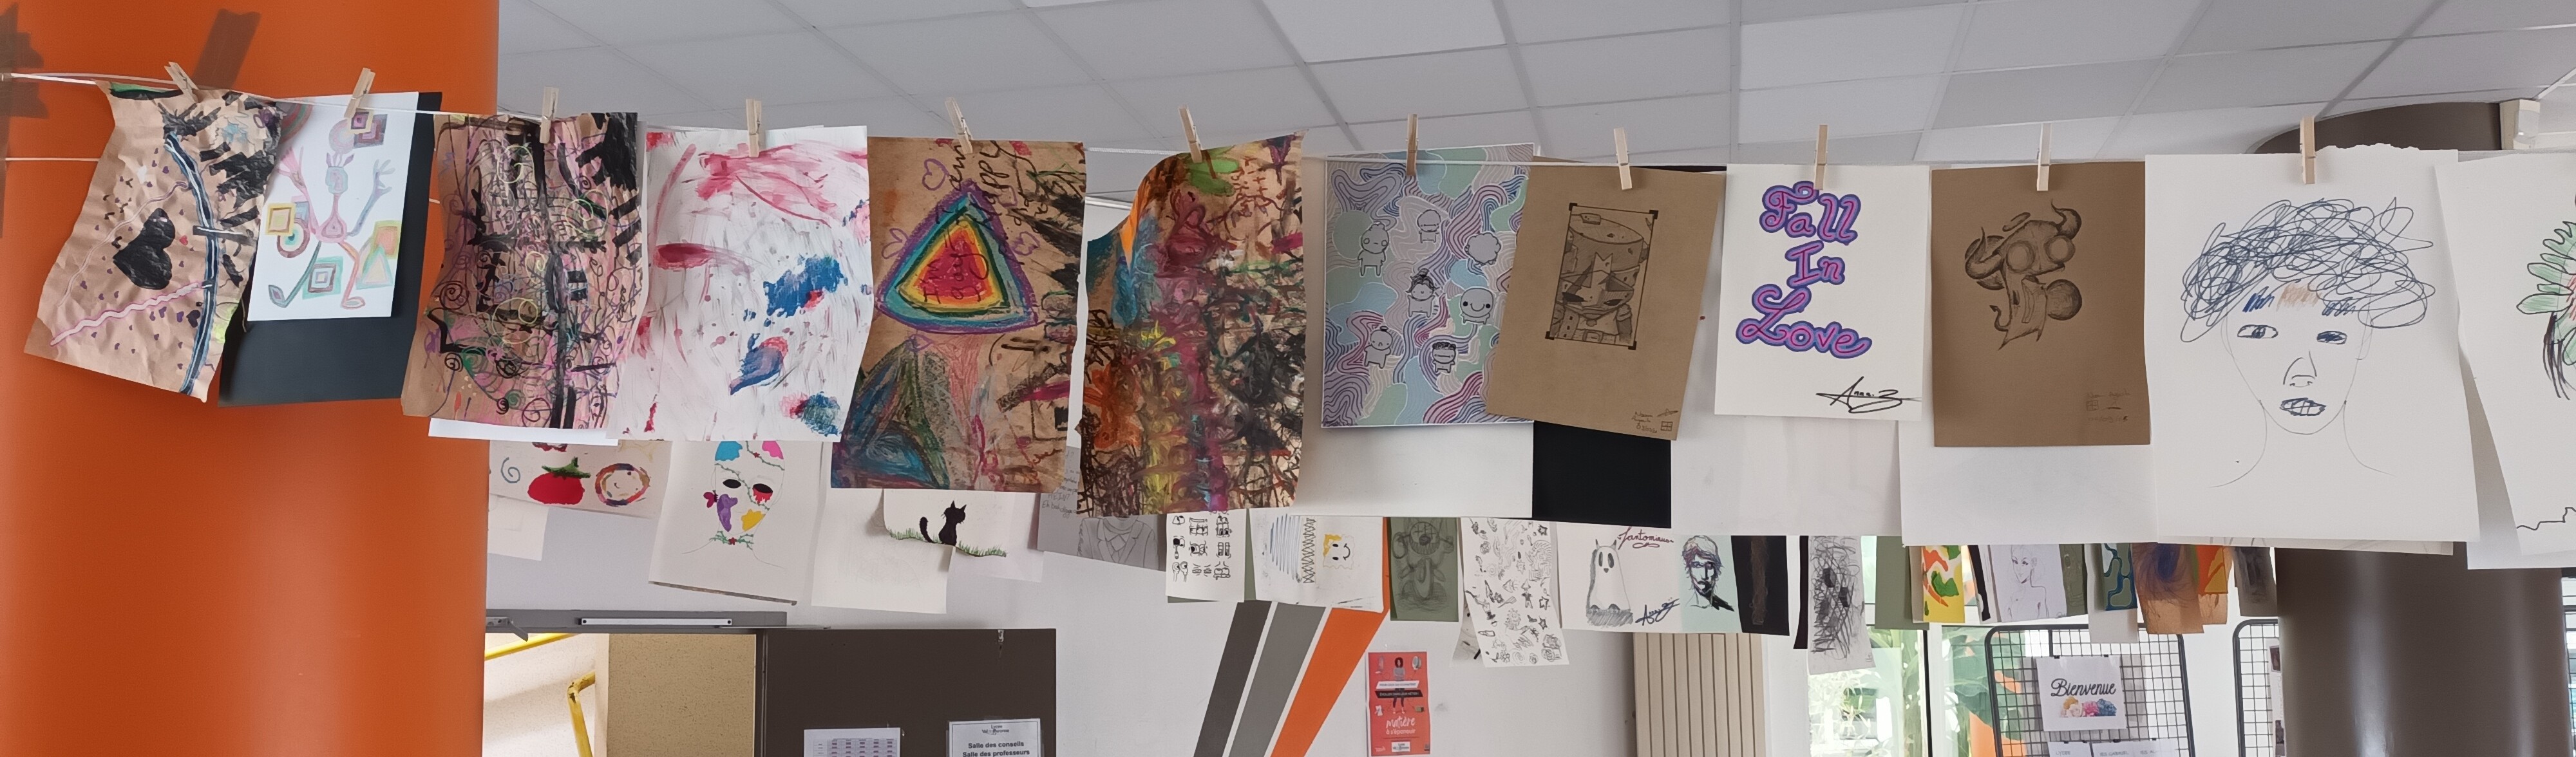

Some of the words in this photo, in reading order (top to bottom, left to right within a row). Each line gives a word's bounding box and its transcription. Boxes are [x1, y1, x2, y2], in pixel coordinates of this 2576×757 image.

[1759, 180, 1861, 246] Fall
[1785, 239, 1846, 290] In
[1736, 283, 1873, 359] Love
[2050, 678, 2117, 697] Bienvenue
[1386, 715, 1416, 729] matière
